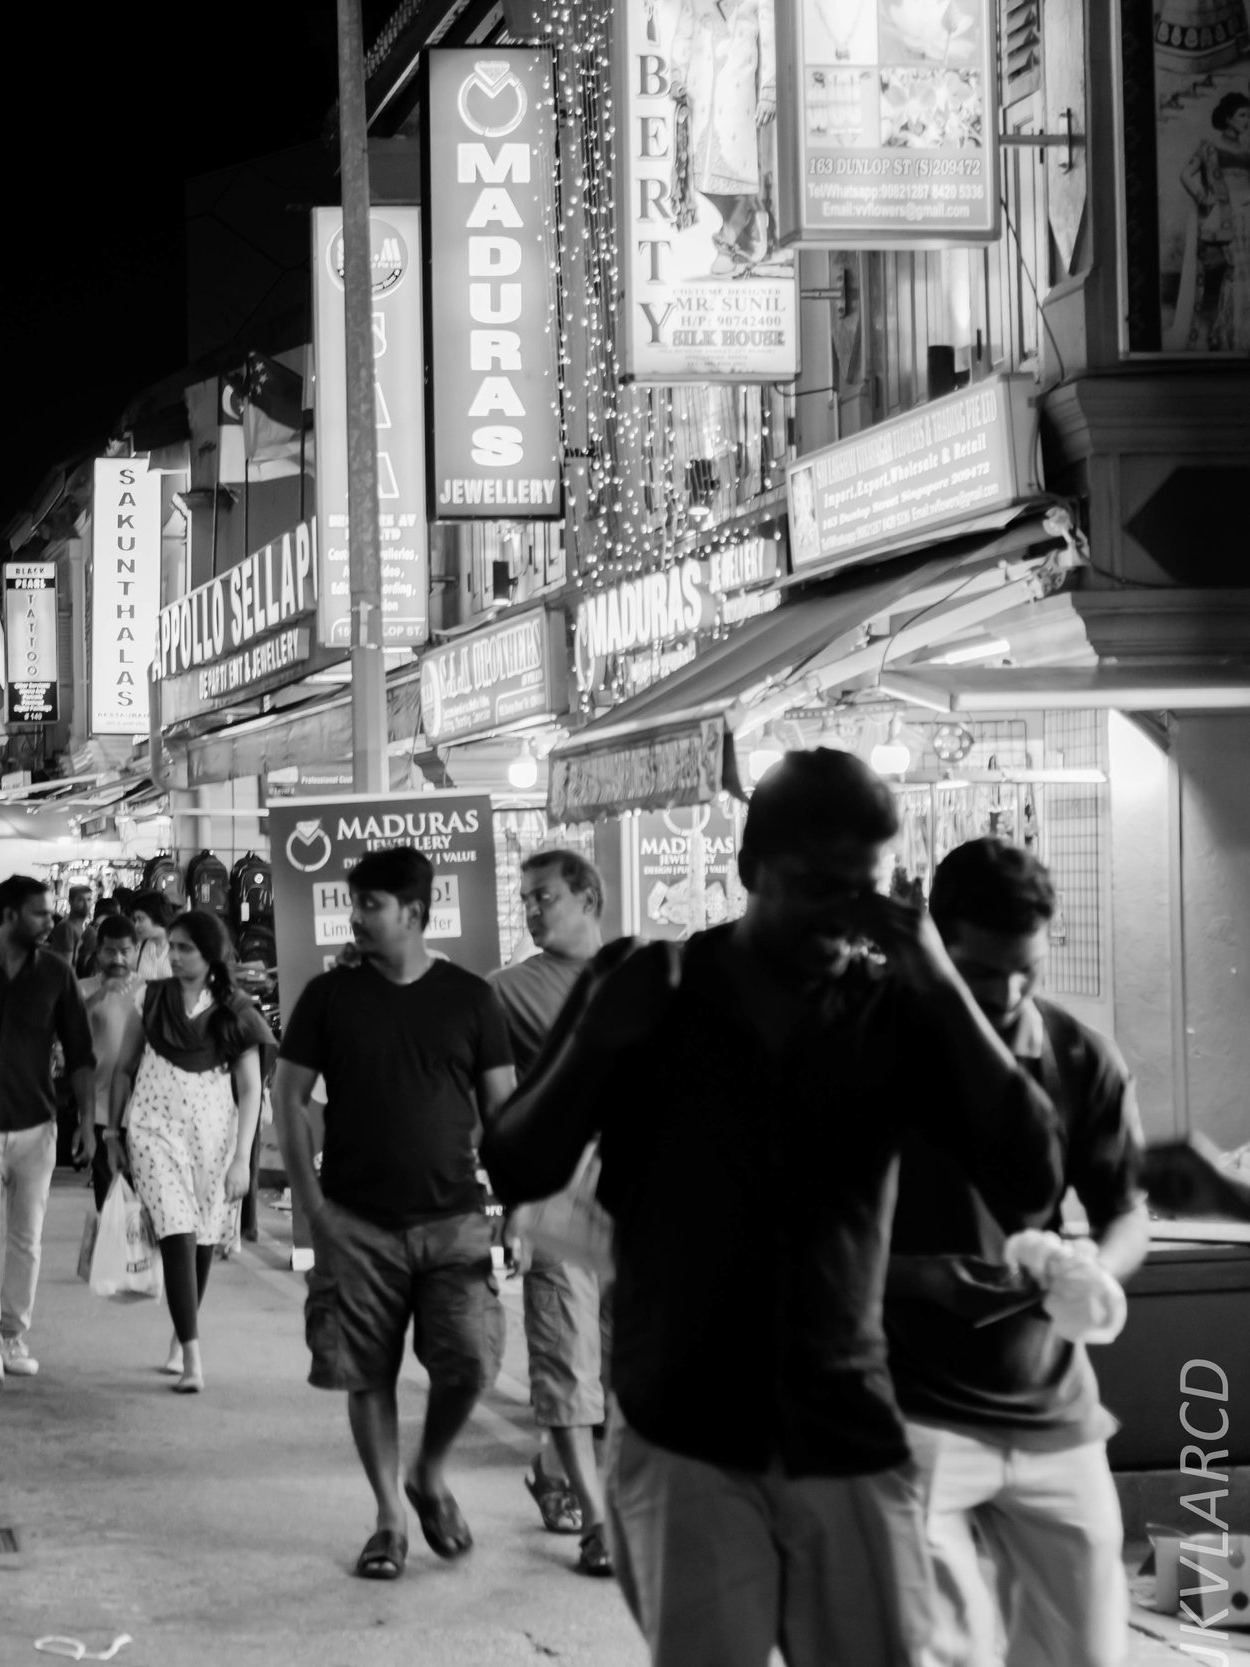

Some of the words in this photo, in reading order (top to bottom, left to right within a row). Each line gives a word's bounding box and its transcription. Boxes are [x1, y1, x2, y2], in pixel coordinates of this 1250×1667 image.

[809, 157, 833, 176] 163
[836, 157, 890, 176] DUNLOP
[894, 157, 912, 176] ST
[915, 157, 982, 178] (S)209472
[457, 142, 530, 467] MADURAS
[676, 297, 715, 312] MR.
[721, 297, 786, 312] SUNIL
[672, 329, 718, 347] SILK
[721, 329, 786, 347] HOUSE
[953, 432, 988, 461] Retail
[440, 479, 556, 505] JEWELLERY
[14, 578, 46, 589] PEARL
[15, 567, 45, 575] BLACK
[116, 468, 137, 707] SAKUNTHALAS
[586, 558, 703, 659] MADURAS
[26, 594, 38, 677] TATTOO
[151, 579, 225, 683] APPOLLO
[251, 627, 299, 681] JEWELLERY
[336, 809, 480, 841] MADURAS
[442, 849, 478, 863] VALUE
